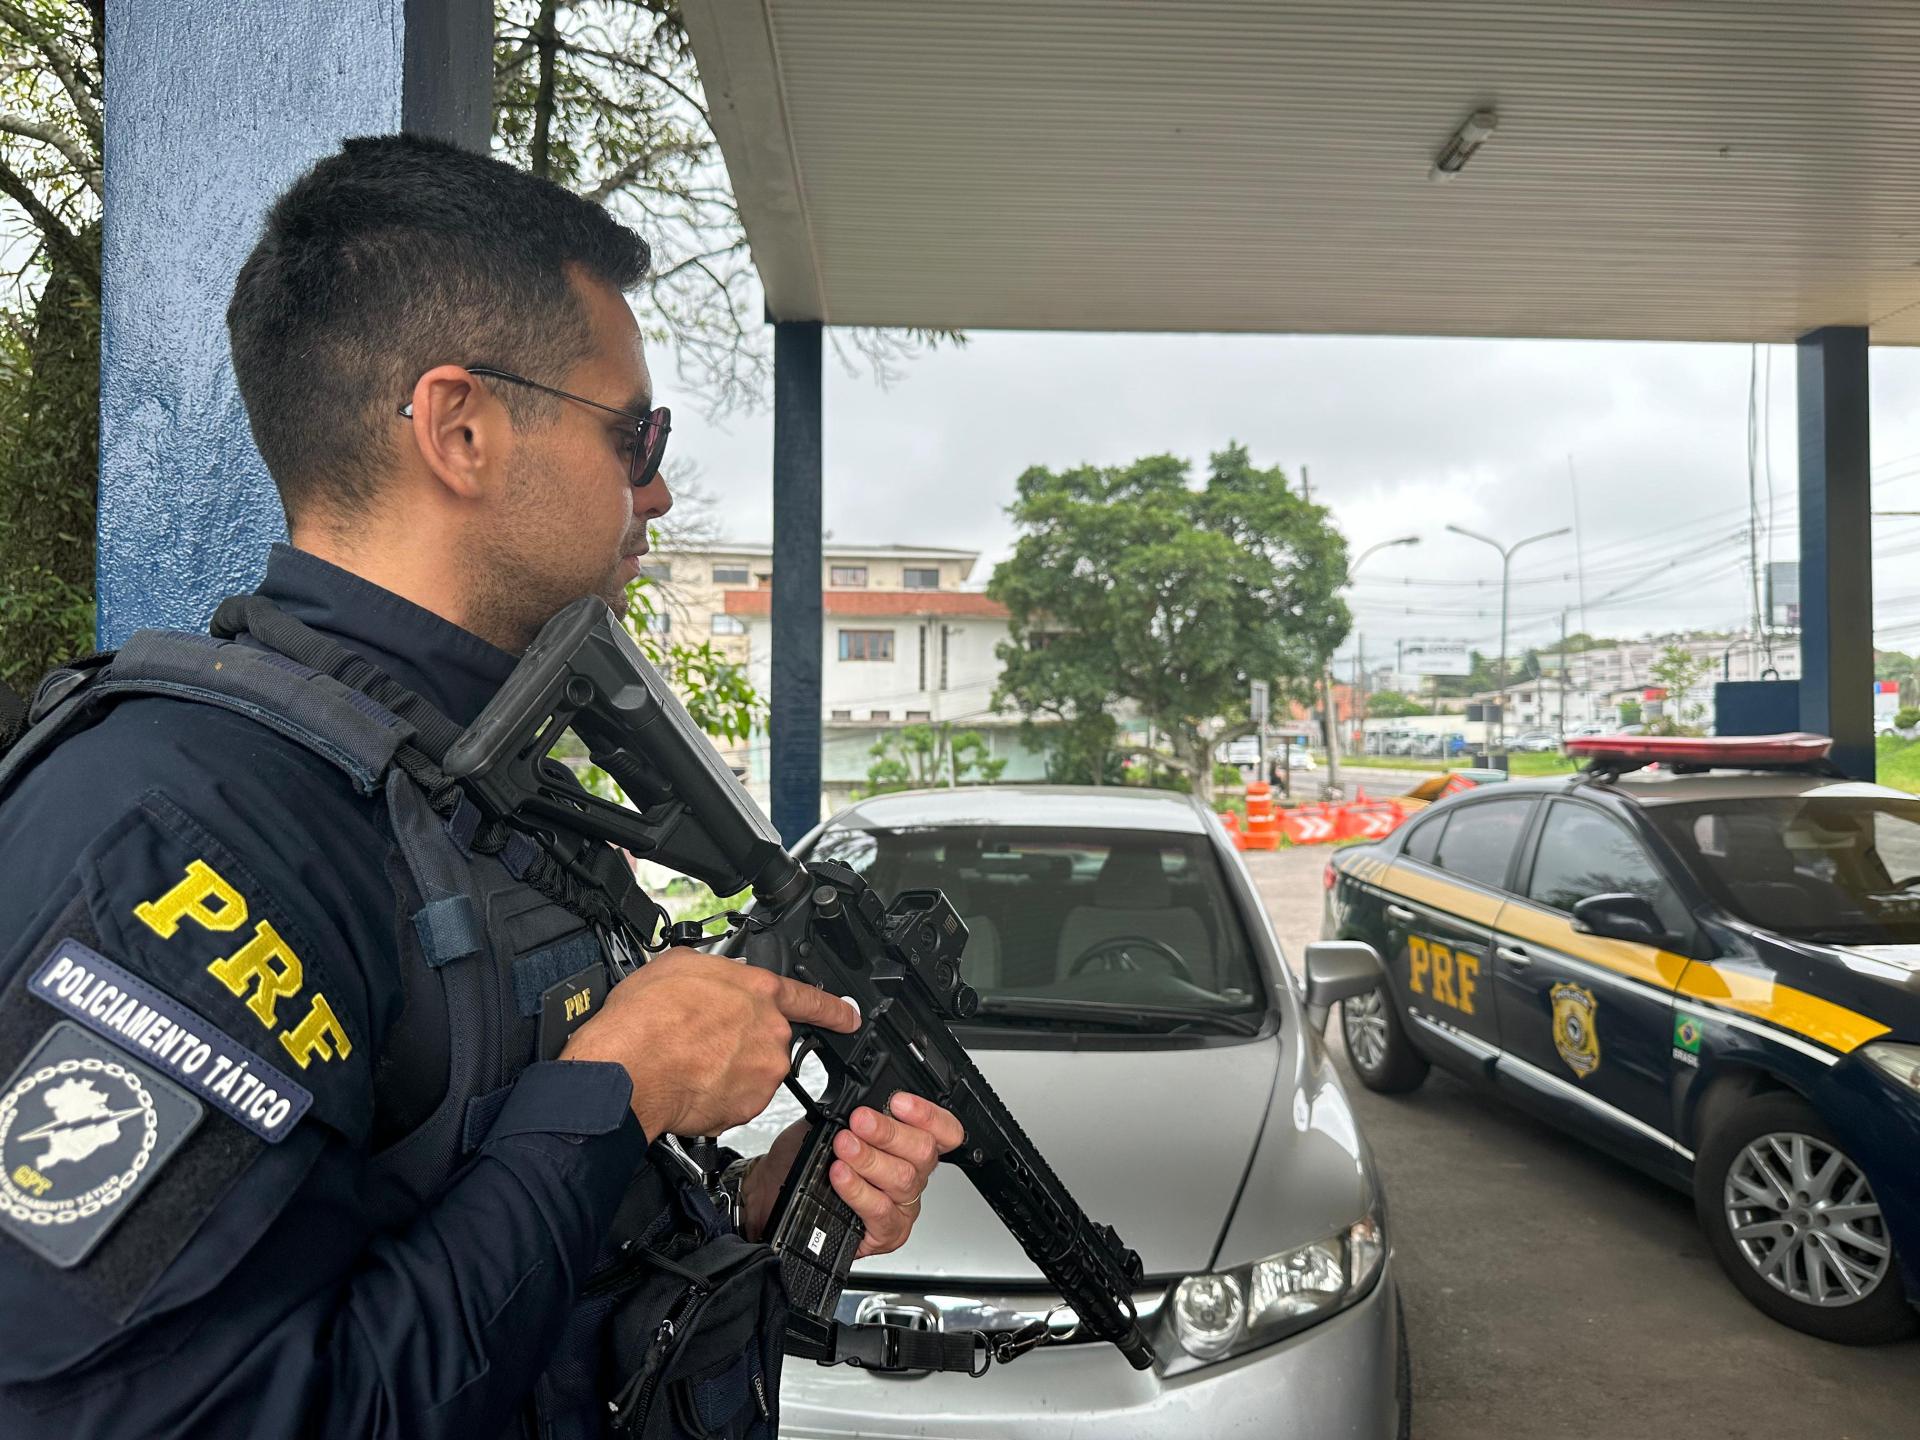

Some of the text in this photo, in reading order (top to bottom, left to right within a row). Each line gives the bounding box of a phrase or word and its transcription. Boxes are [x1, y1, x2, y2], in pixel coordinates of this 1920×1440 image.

[133, 858, 353, 1070] PRF
[564, 987, 591, 1021] PRF
[1407, 934, 1481, 1016] PRF
[42, 957, 292, 1129] POLICIAMENTO TÁTICO
[75, 1175, 119, 1206] TÁTICO
